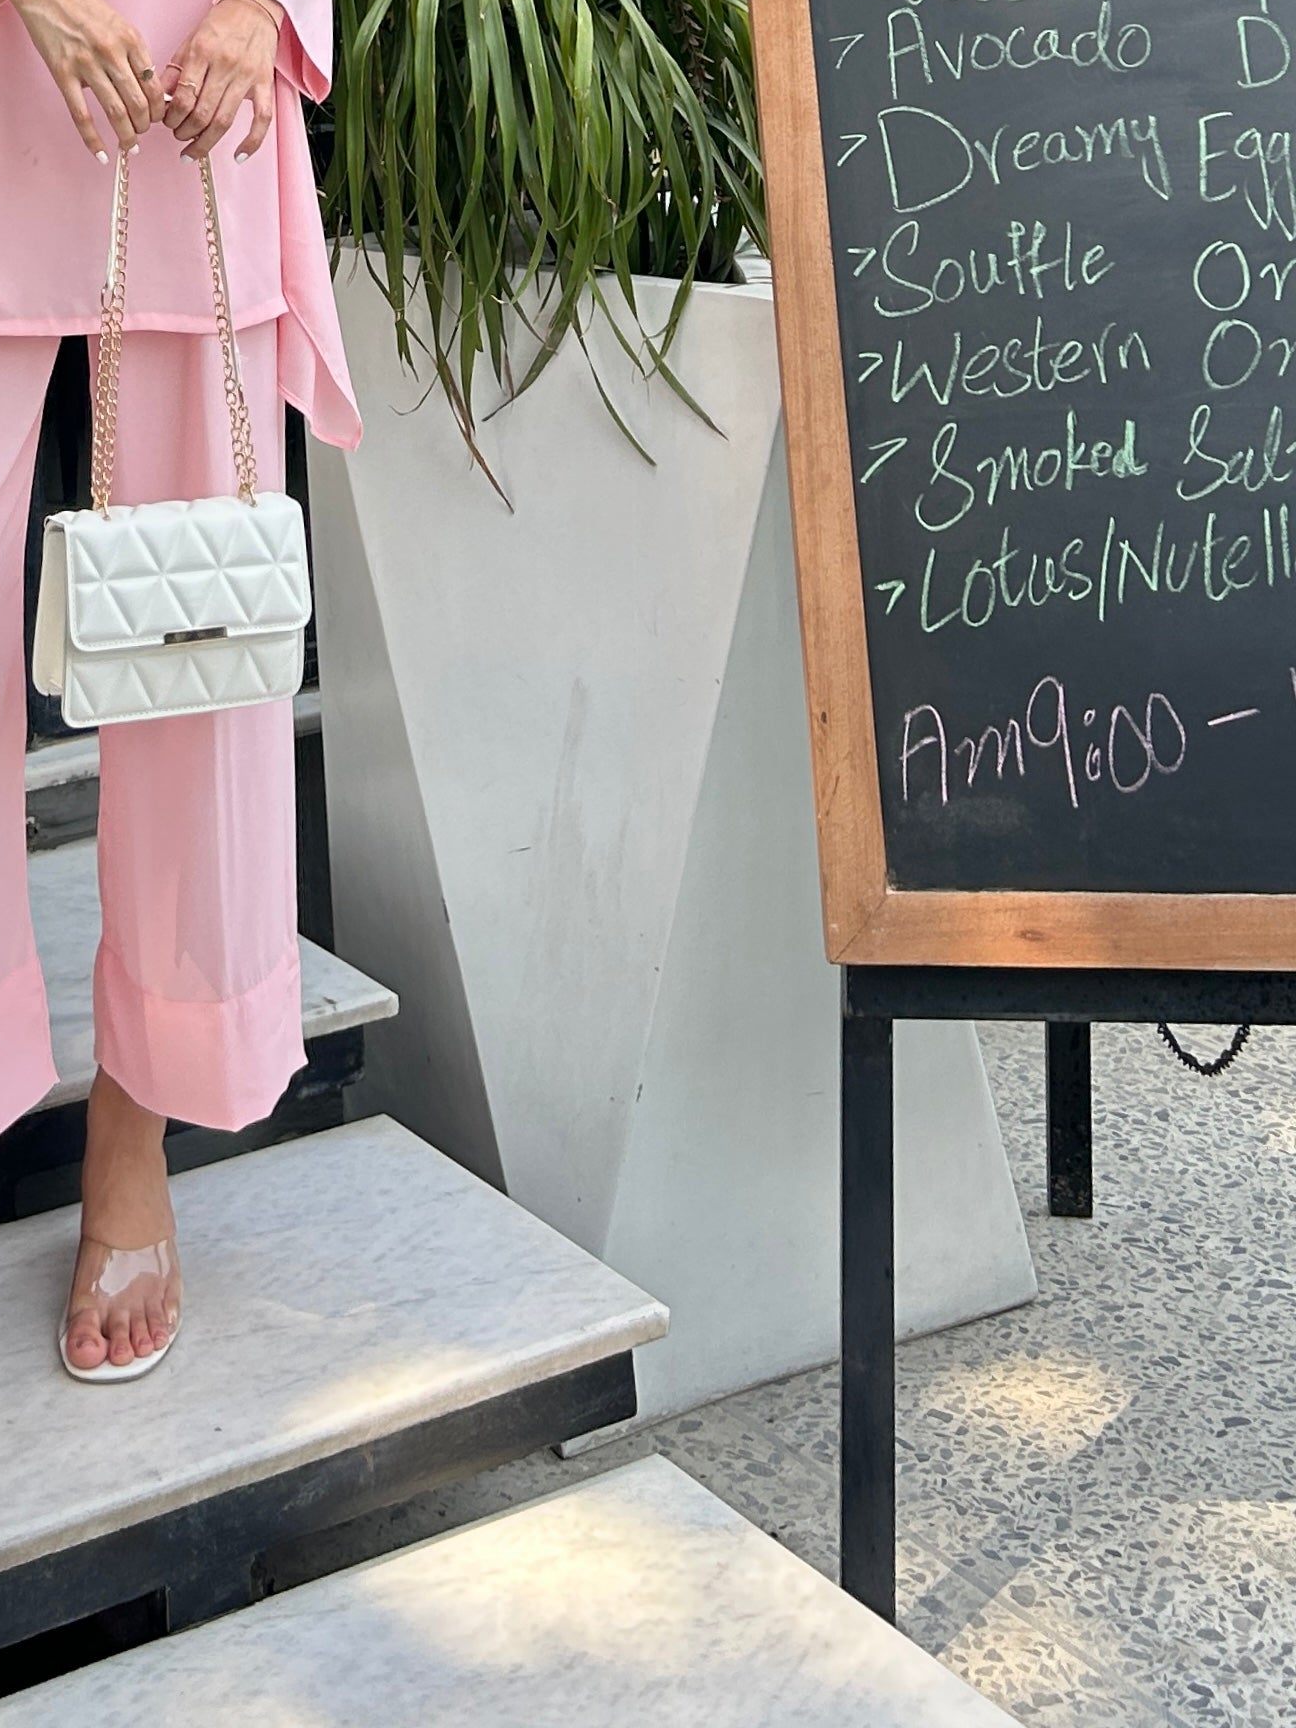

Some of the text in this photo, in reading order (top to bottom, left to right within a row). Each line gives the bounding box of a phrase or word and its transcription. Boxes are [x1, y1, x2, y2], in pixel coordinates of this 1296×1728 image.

[886, 0, 1153, 100] Avocado
[876, 105, 1174, 214] Dreamy
[888, 314, 1152, 406] Western
[913, 410, 1150, 533] Smoked
